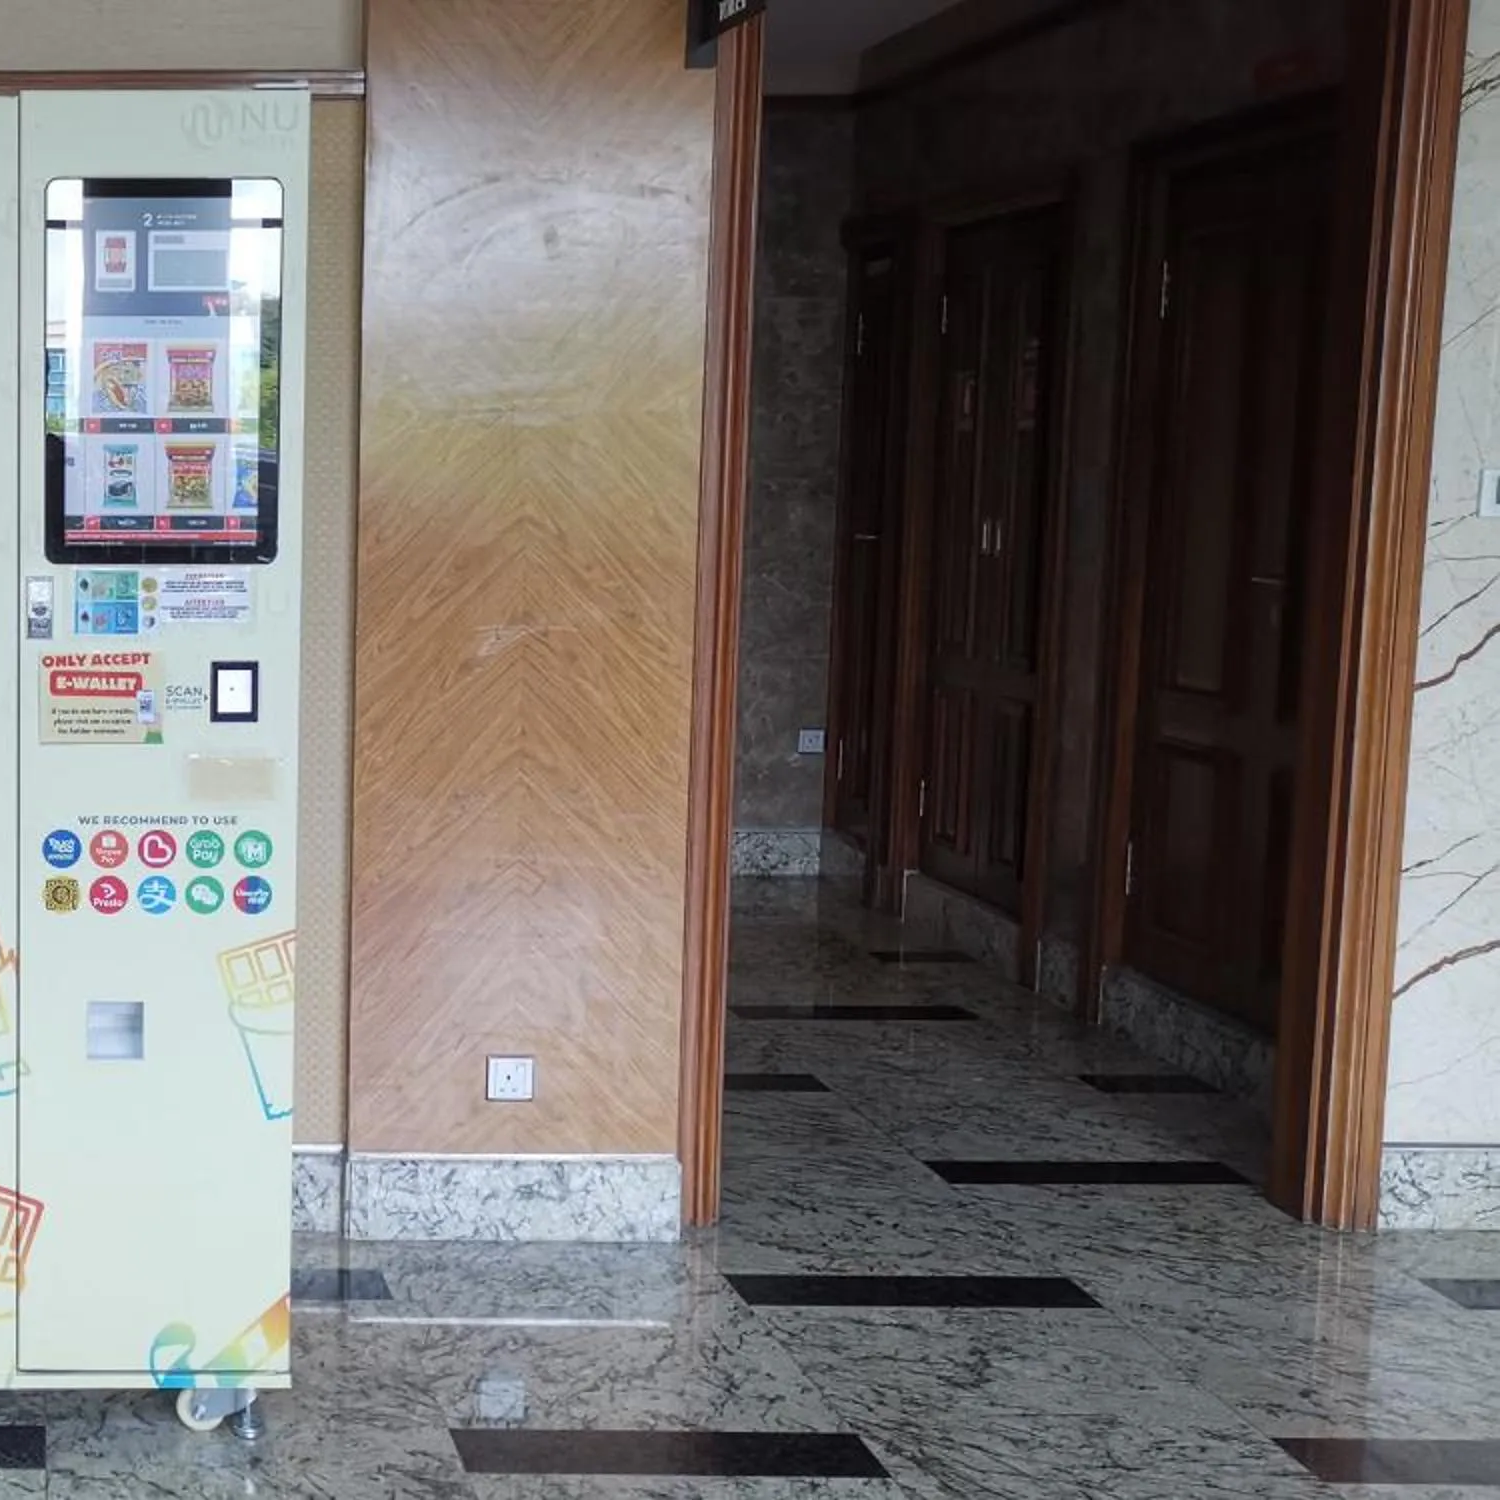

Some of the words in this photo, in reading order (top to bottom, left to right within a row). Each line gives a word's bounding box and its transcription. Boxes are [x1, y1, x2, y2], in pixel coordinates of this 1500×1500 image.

[42, 655, 87, 667] ONLY
[91, 653, 152, 666] ACCEPT
[55, 676, 138, 691] E-WALLET
[165, 685, 203, 697] SCAN
[78, 815, 100, 825] WE
[103, 815, 189, 825] RECOMMEND
[192, 815, 210, 825] TO
[213, 815, 238, 825] USE
[193, 849, 219, 863] Pay
[93, 898, 123, 908] Presto
